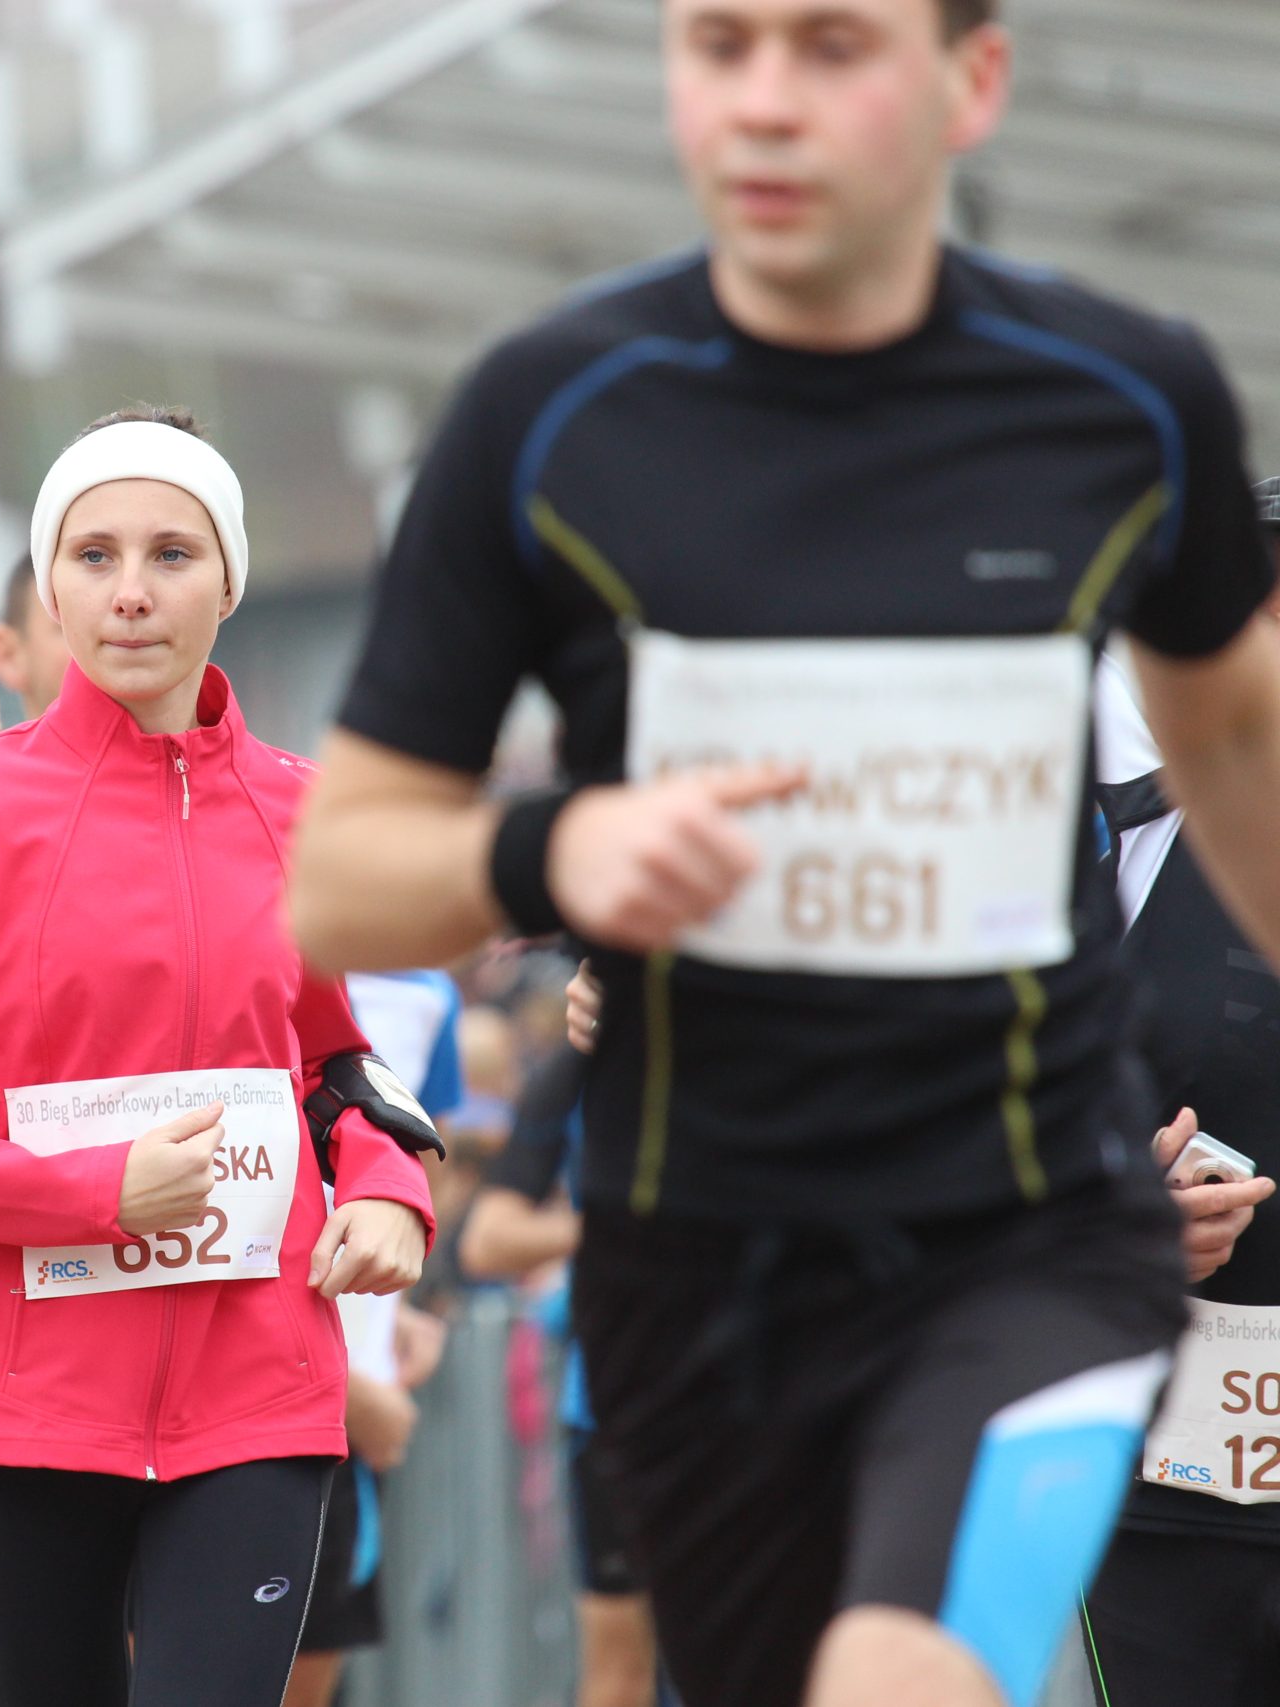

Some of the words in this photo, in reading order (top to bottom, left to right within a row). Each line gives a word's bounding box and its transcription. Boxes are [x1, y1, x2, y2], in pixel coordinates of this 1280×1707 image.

[780, 846, 940, 943] 661
[16, 1101, 38, 1124] 30.
[40, 1099, 70, 1126] Bieg
[72, 1090, 160, 1119] Barbórkowy
[163, 1093, 173, 1109] o
[232, 1081, 287, 1111] Górniczą
[1185, 1315, 1213, 1342] ieg
[1221, 1370, 1280, 1416] SO
[1224, 1434, 1280, 1490] 12
